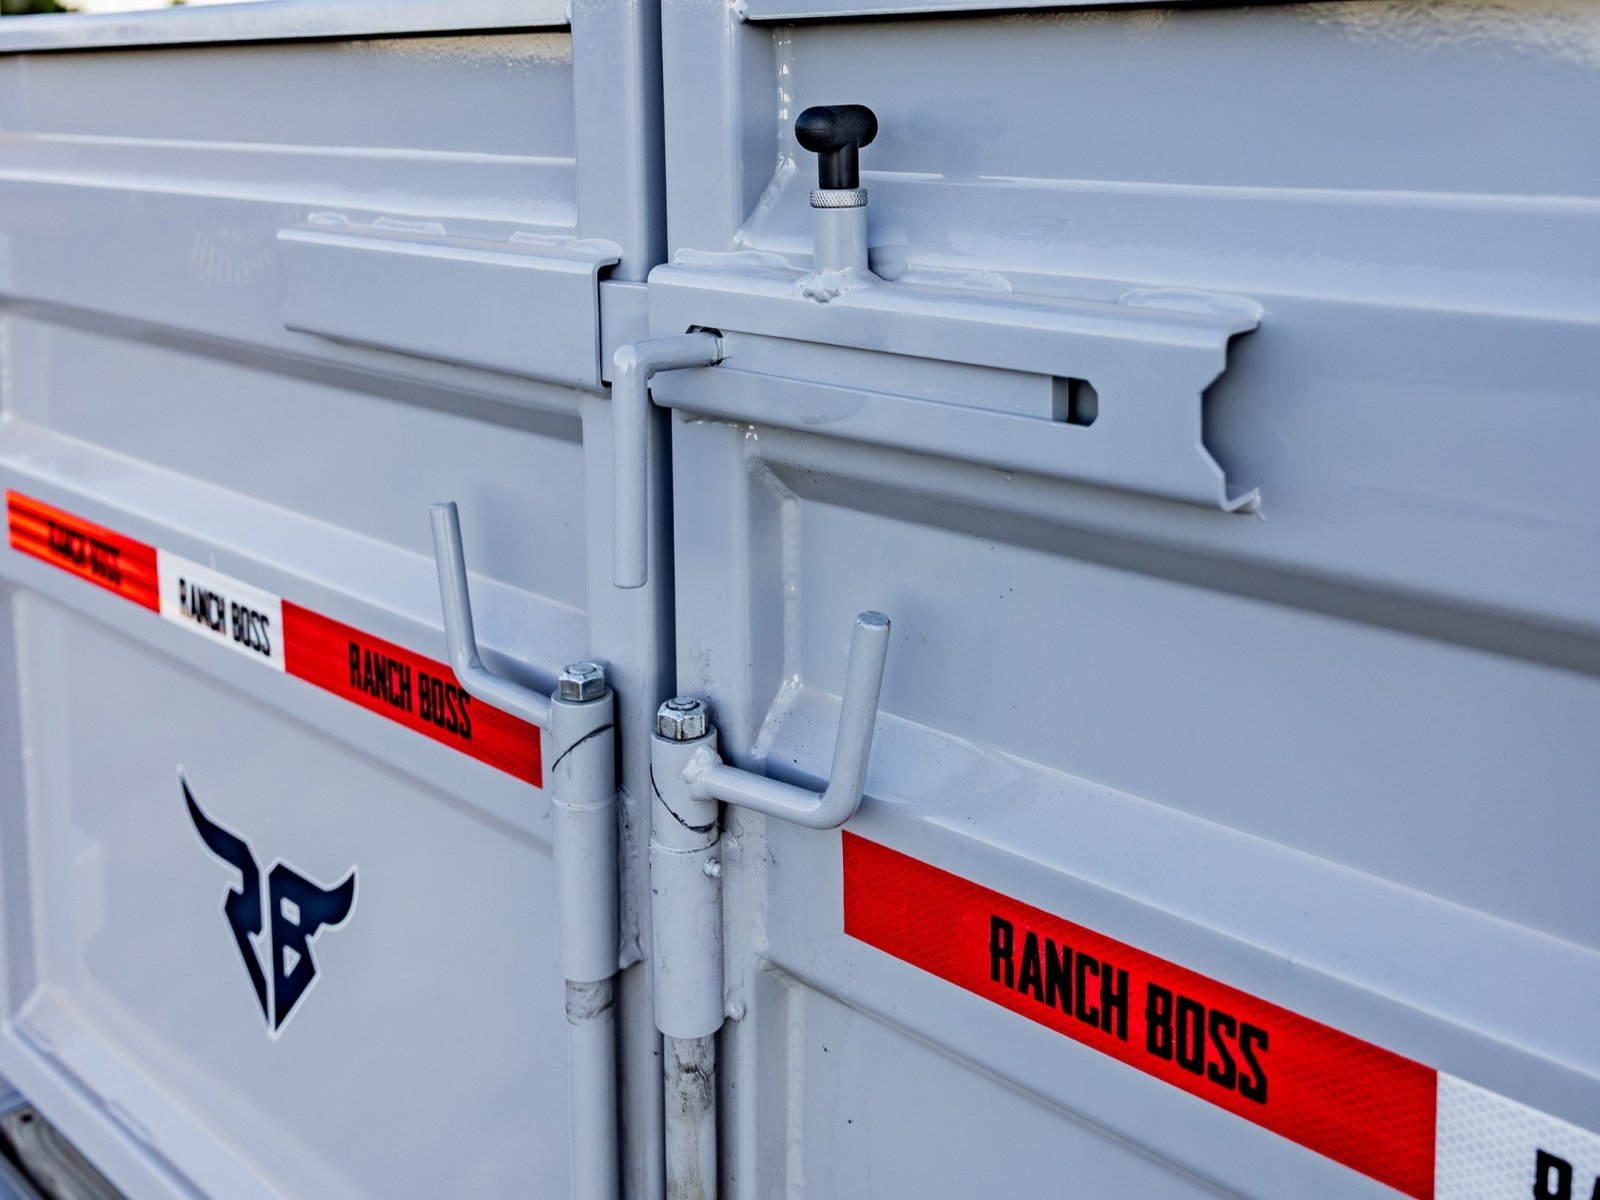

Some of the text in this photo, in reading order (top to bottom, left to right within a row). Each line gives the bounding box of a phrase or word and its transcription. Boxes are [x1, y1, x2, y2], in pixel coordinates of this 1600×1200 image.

[179, 578, 270, 657] RANCH BOSS
[349, 641, 472, 740] RANCH BOSS
[989, 913, 1269, 1105] RANCH BOSS
